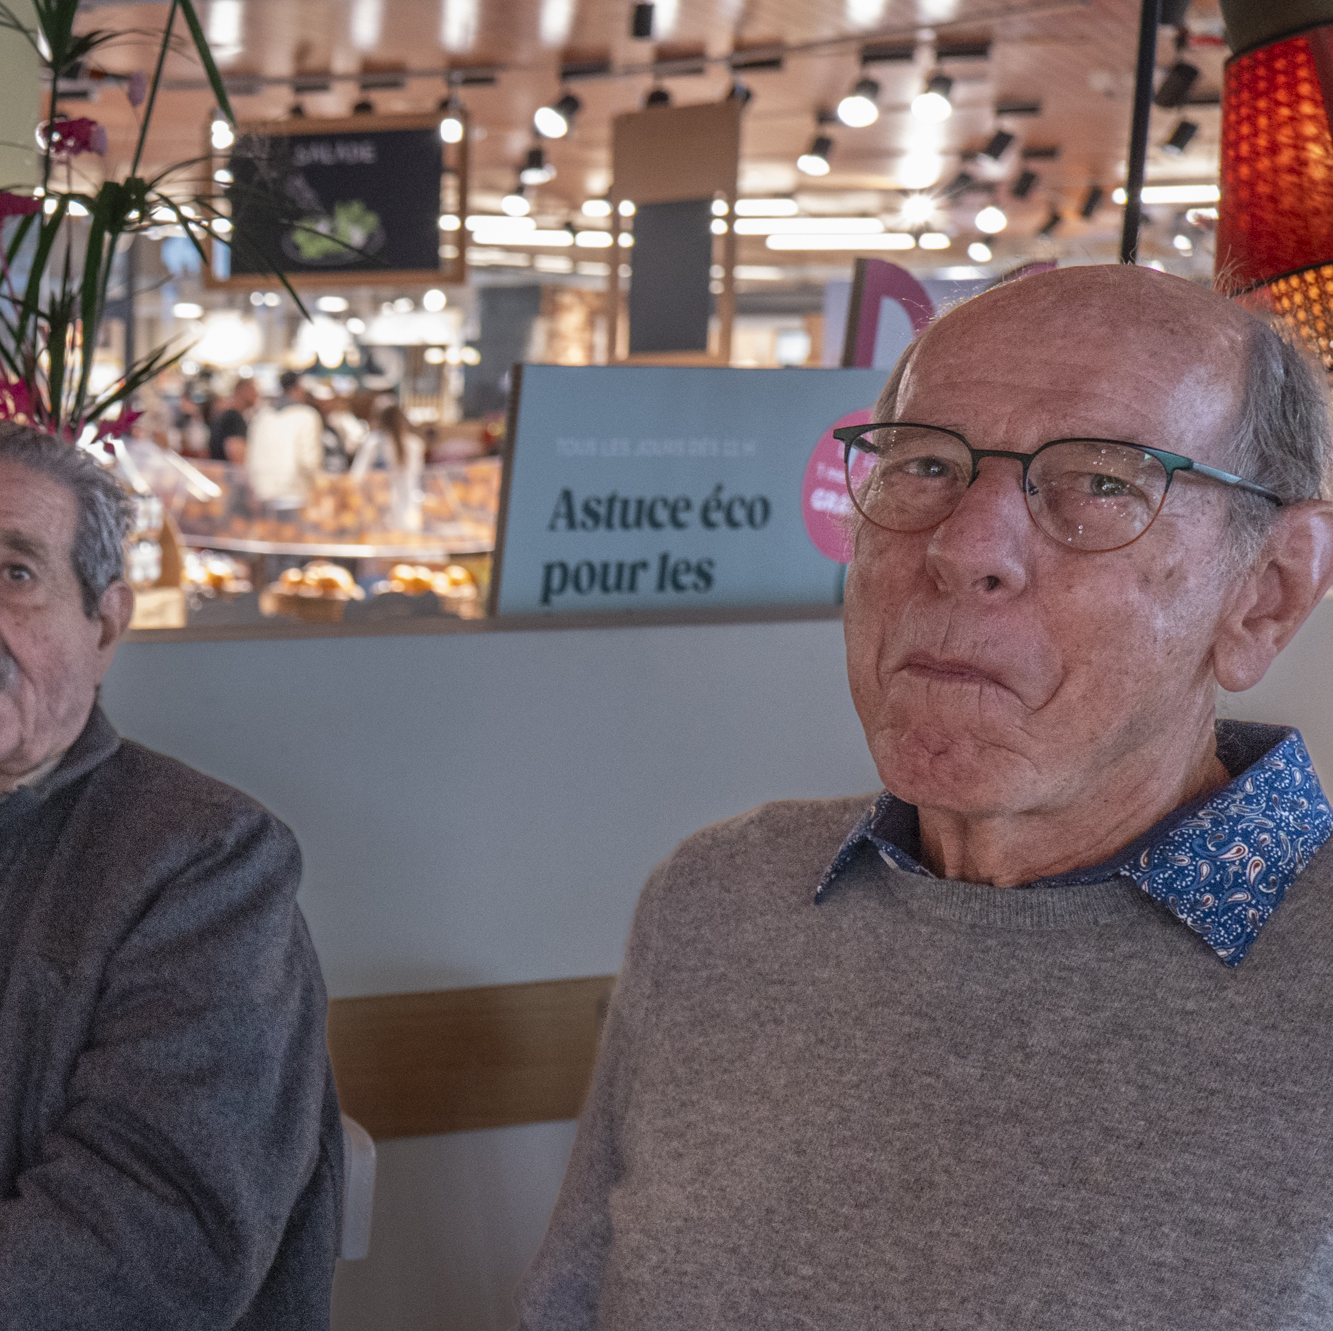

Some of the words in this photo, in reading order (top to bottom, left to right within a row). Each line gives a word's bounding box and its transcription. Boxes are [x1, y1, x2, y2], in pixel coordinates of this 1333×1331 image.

[547, 486, 692, 532] Astuce
[699, 482, 772, 531] éco
[540, 558, 649, 607] pour
[656, 551, 715, 595] les
